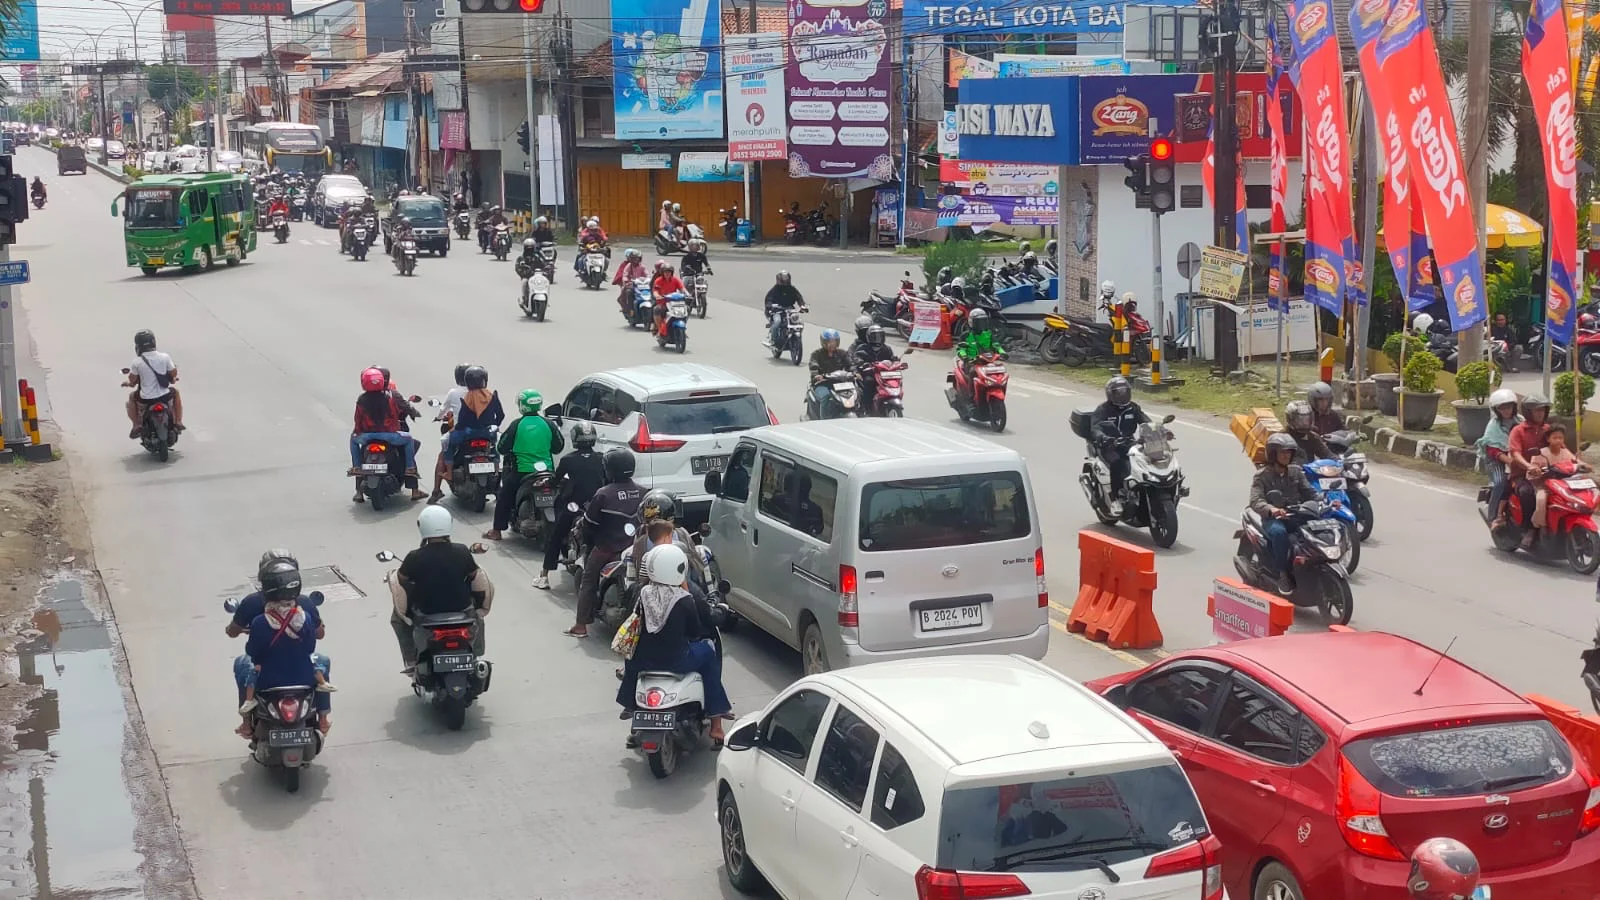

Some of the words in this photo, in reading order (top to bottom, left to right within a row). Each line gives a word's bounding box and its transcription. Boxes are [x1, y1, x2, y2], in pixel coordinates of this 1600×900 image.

[924, 6, 1003, 27] TEGAL
[1014, 5, 1078, 26] KOTA
[807, 44, 868, 63] Ramadan
[994, 104, 1056, 137] MAYA
[1101, 106, 1137, 124] 2Tang
[732, 127, 781, 137] merahputih
[964, 205, 979, 213] 21
[923, 612, 930, 623] B
[934, 609, 957, 621] 2024
[962, 606, 979, 618] POY
[1216, 608, 1250, 633] smartfren
